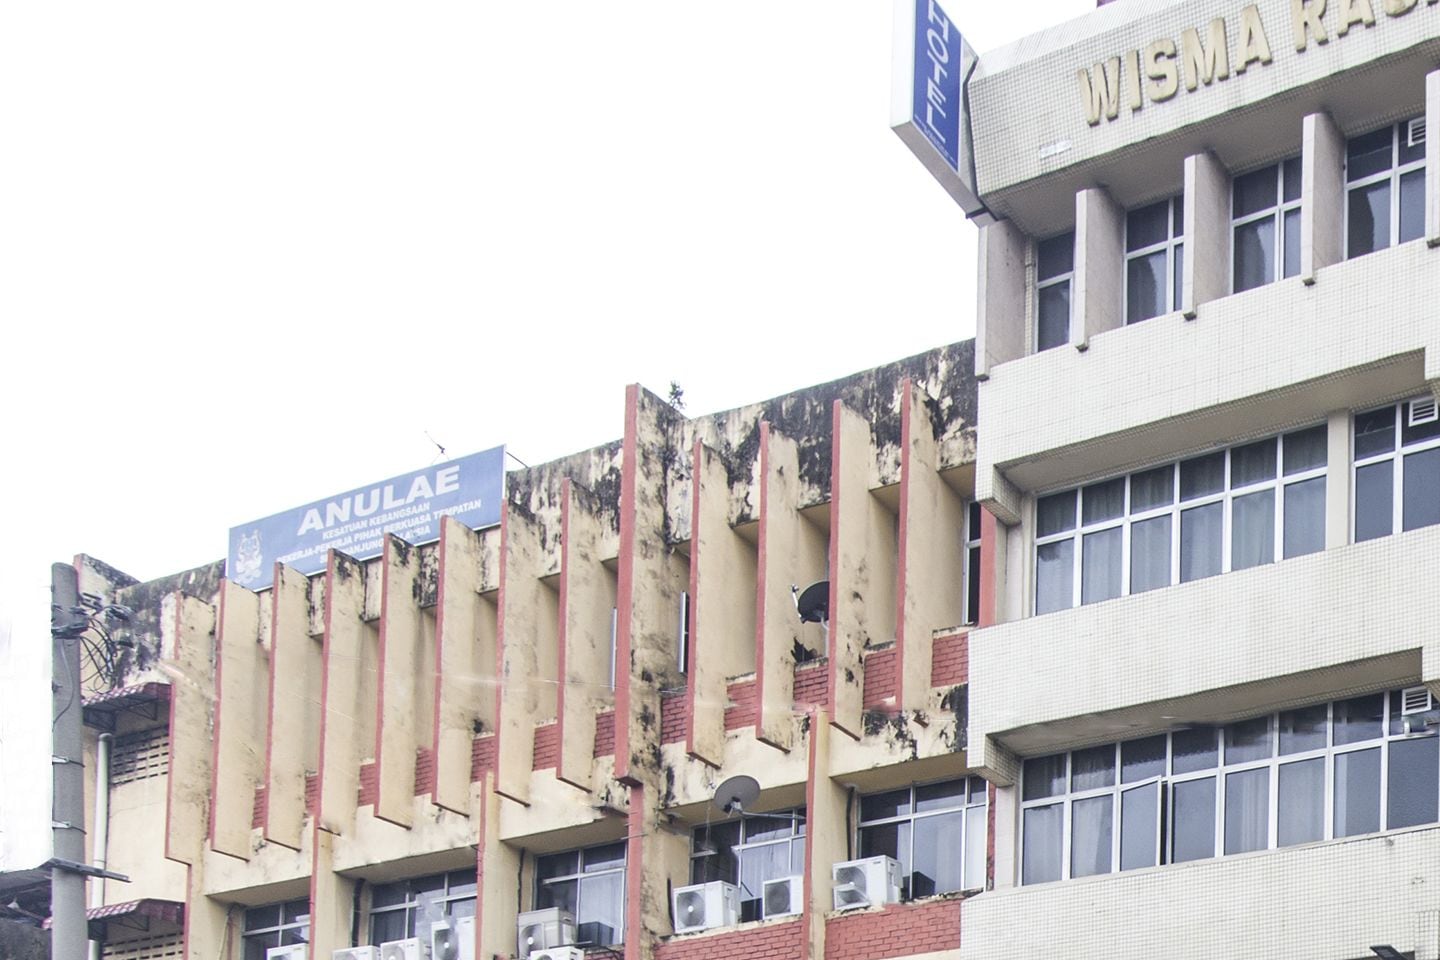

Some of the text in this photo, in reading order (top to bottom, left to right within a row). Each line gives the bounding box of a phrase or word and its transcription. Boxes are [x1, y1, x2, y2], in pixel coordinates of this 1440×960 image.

[927, 0, 949, 144] HOTEL
[1077, 7, 1273, 127] WISMA
[297, 464, 460, 536] ANULAE
